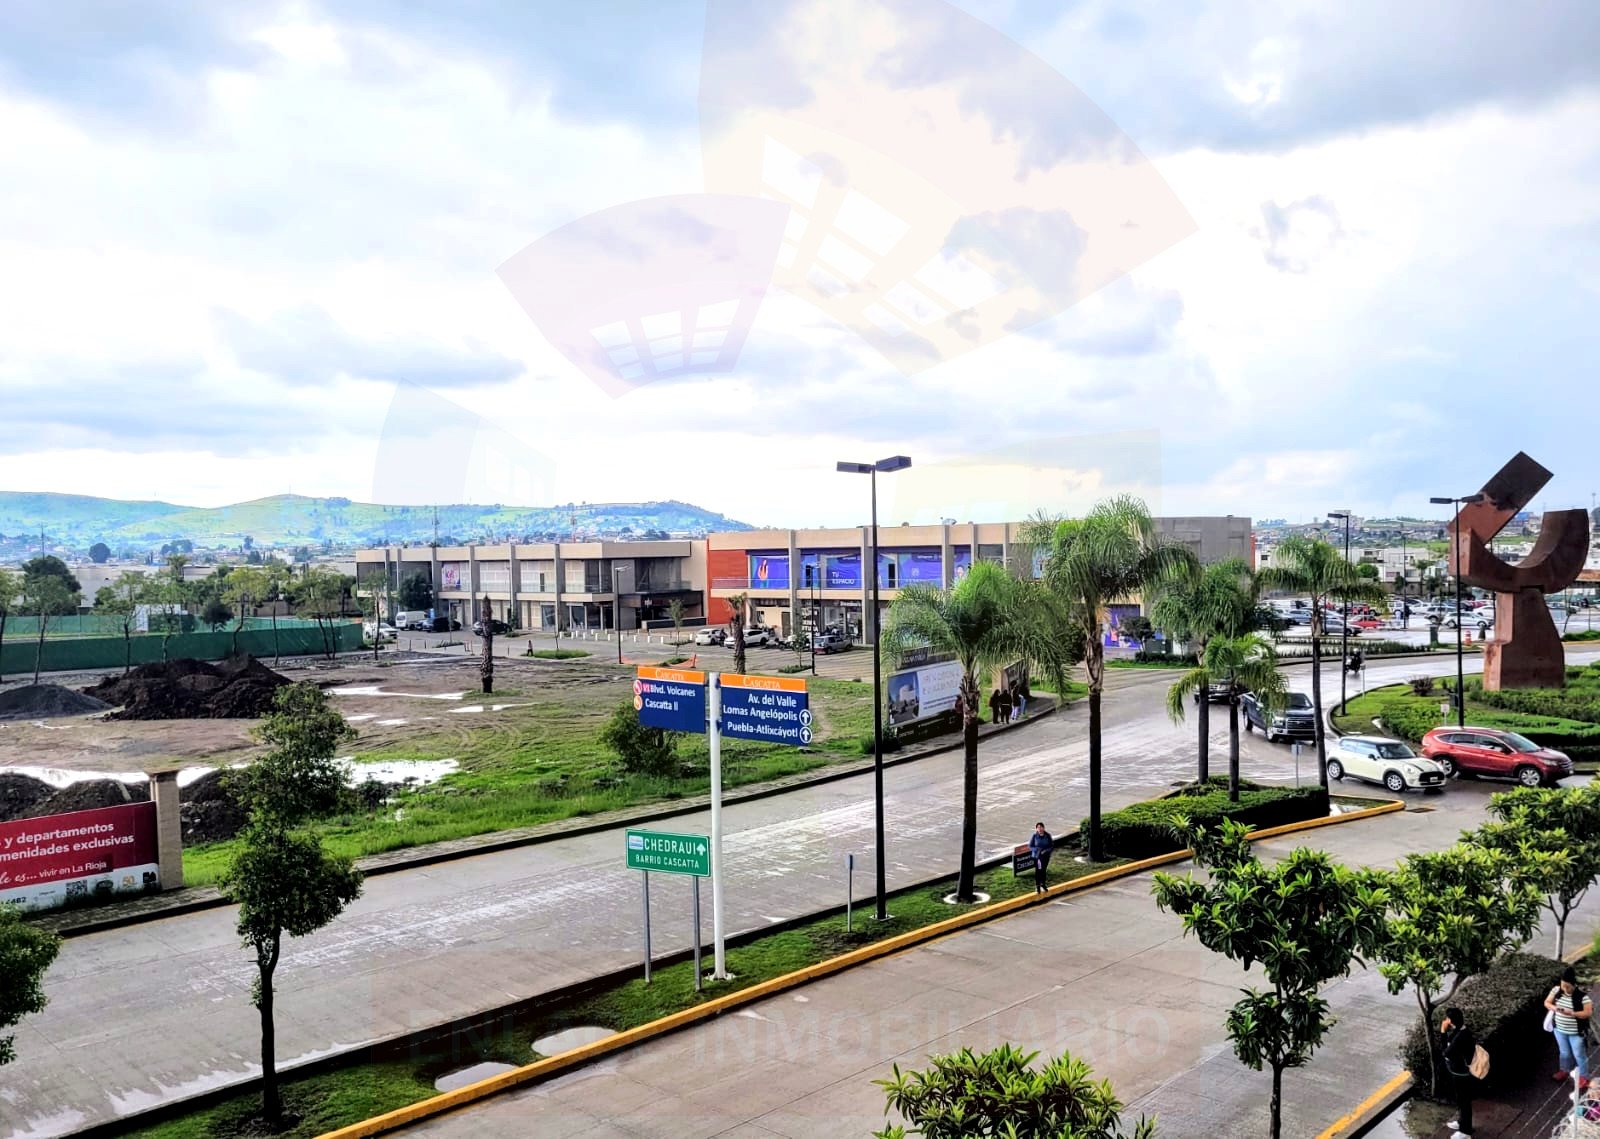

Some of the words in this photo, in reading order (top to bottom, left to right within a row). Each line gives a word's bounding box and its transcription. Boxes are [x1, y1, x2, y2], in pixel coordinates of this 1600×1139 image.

[650, 684, 666, 695] Blvd.
[667, 686, 696, 697] Volcanes
[645, 698, 673, 710] Cascatta
[748, 693, 760, 704] Av.
[762, 695, 775, 706] del
[776, 695, 797, 708] Valle
[723, 704, 748, 716] Lomas
[750, 707, 798, 721] Angelópolis
[728, 721, 798, 738] Puebla-Atlixcáyotl
[4, 837, 13, 848] y
[17, 823, 114, 845] departamentos
[73, 835, 135, 851] exclusivas
[644, 838, 696, 855] CHEDRAUI
[39, 869, 57, 878] vivir
[59, 867, 70, 875] en
[72, 865, 83, 873] La
[85, 861, 107, 871] Rioja
[636, 854, 661, 865] BARRIO
[663, 856, 699, 869] CASCATTA
